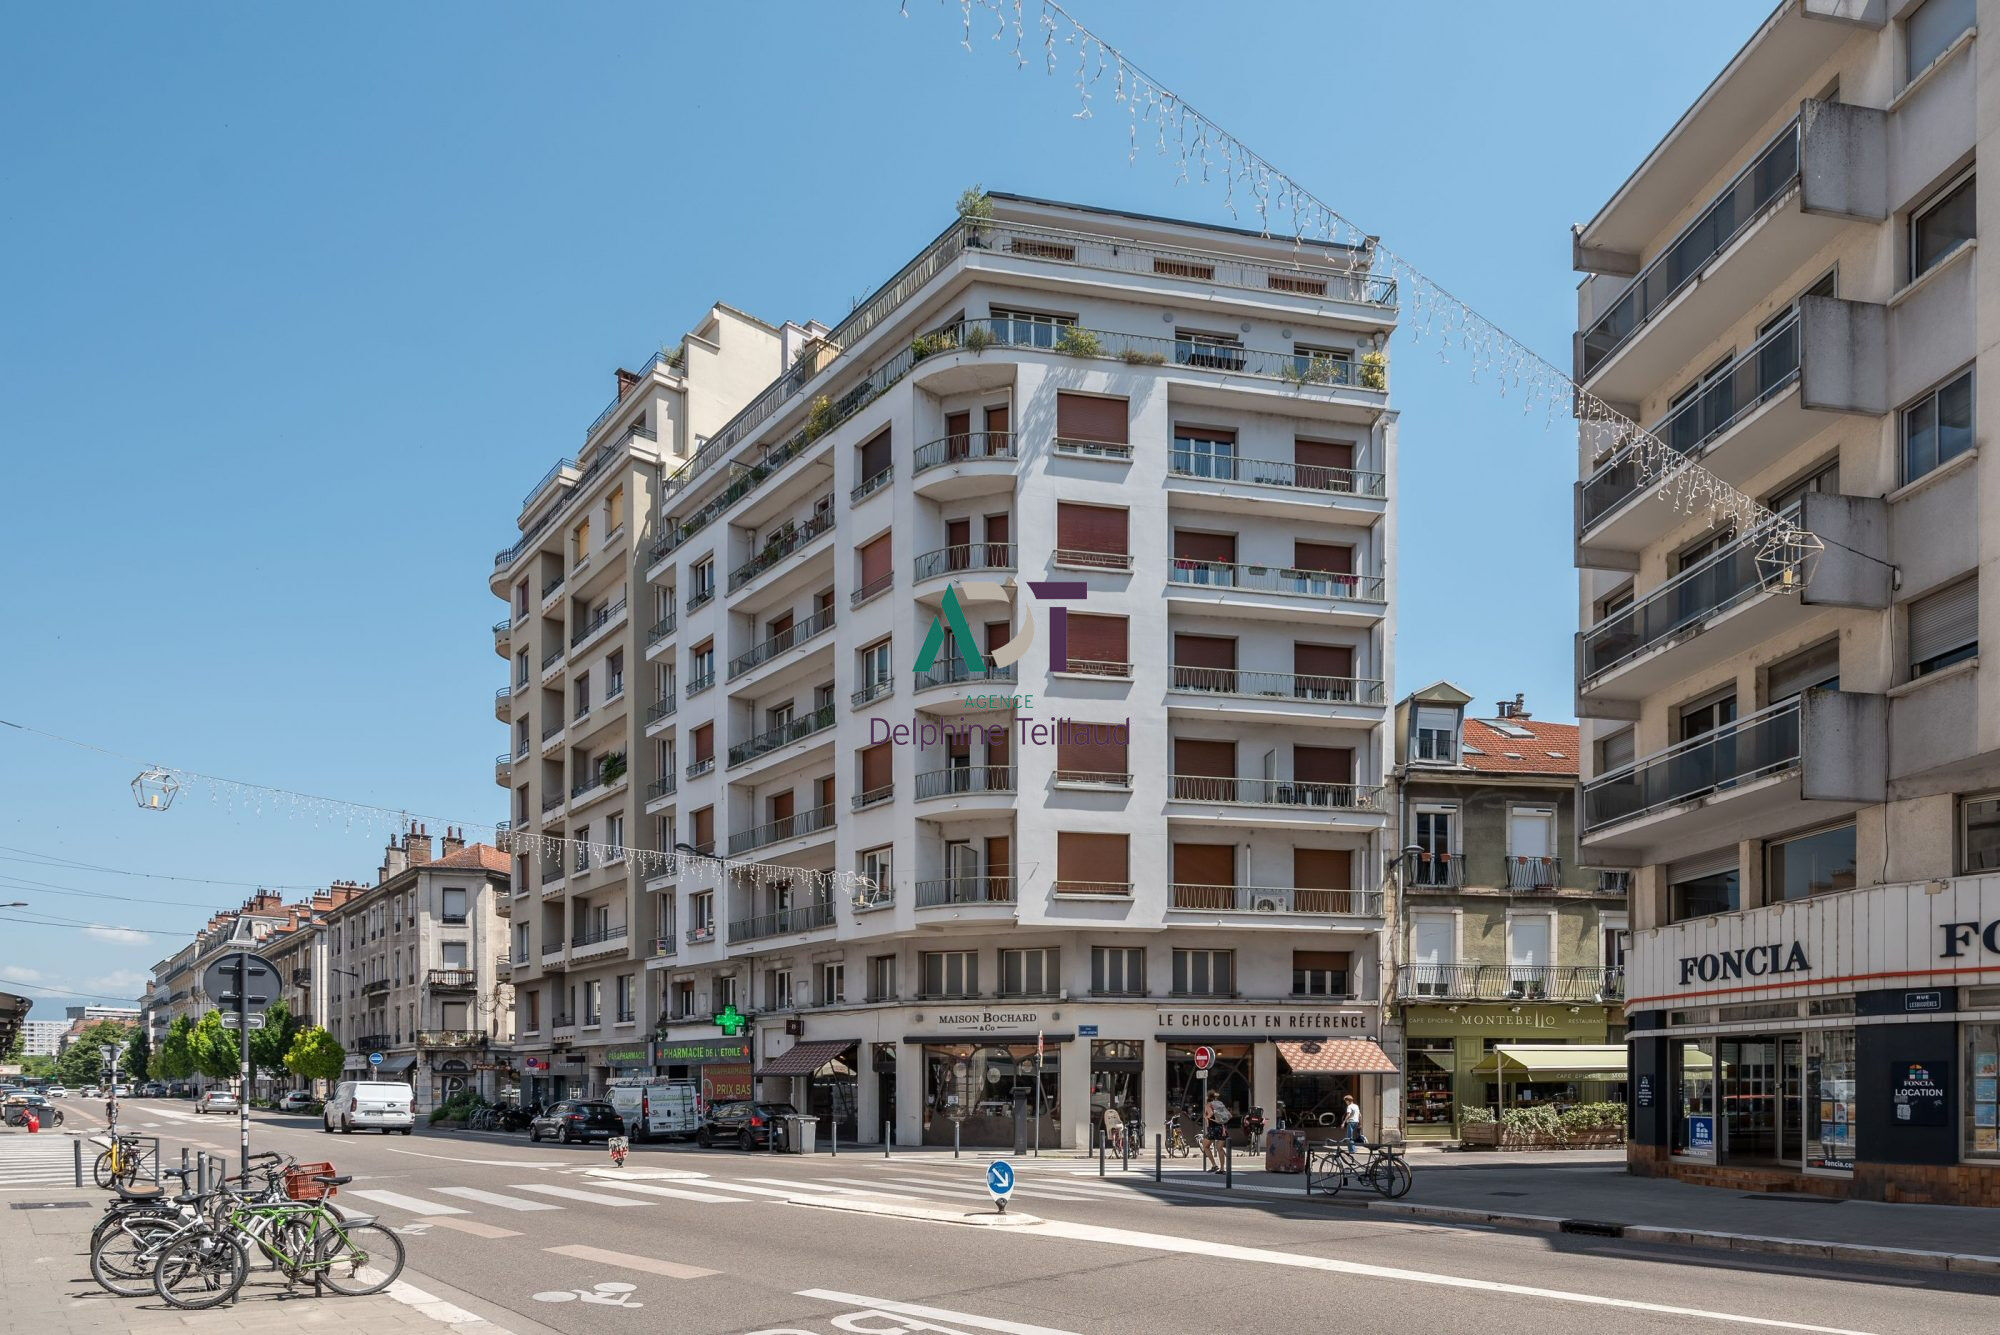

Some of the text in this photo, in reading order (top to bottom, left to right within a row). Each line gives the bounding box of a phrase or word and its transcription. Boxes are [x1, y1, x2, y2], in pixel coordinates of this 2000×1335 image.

[1678, 940, 1812, 985] FONCIA
[939, 1012, 1037, 1024] MAISON BOCHARD
[1158, 1013, 1367, 1028] LE CHOCOLAT EN RÉFÉRENCE
[663, 1047, 704, 1059] PHARMACIE
[705, 1050, 713, 1058] DE
[716, 1084, 752, 1095] PRIX BAS
[1895, 1088, 1943, 1097] LOCATION
